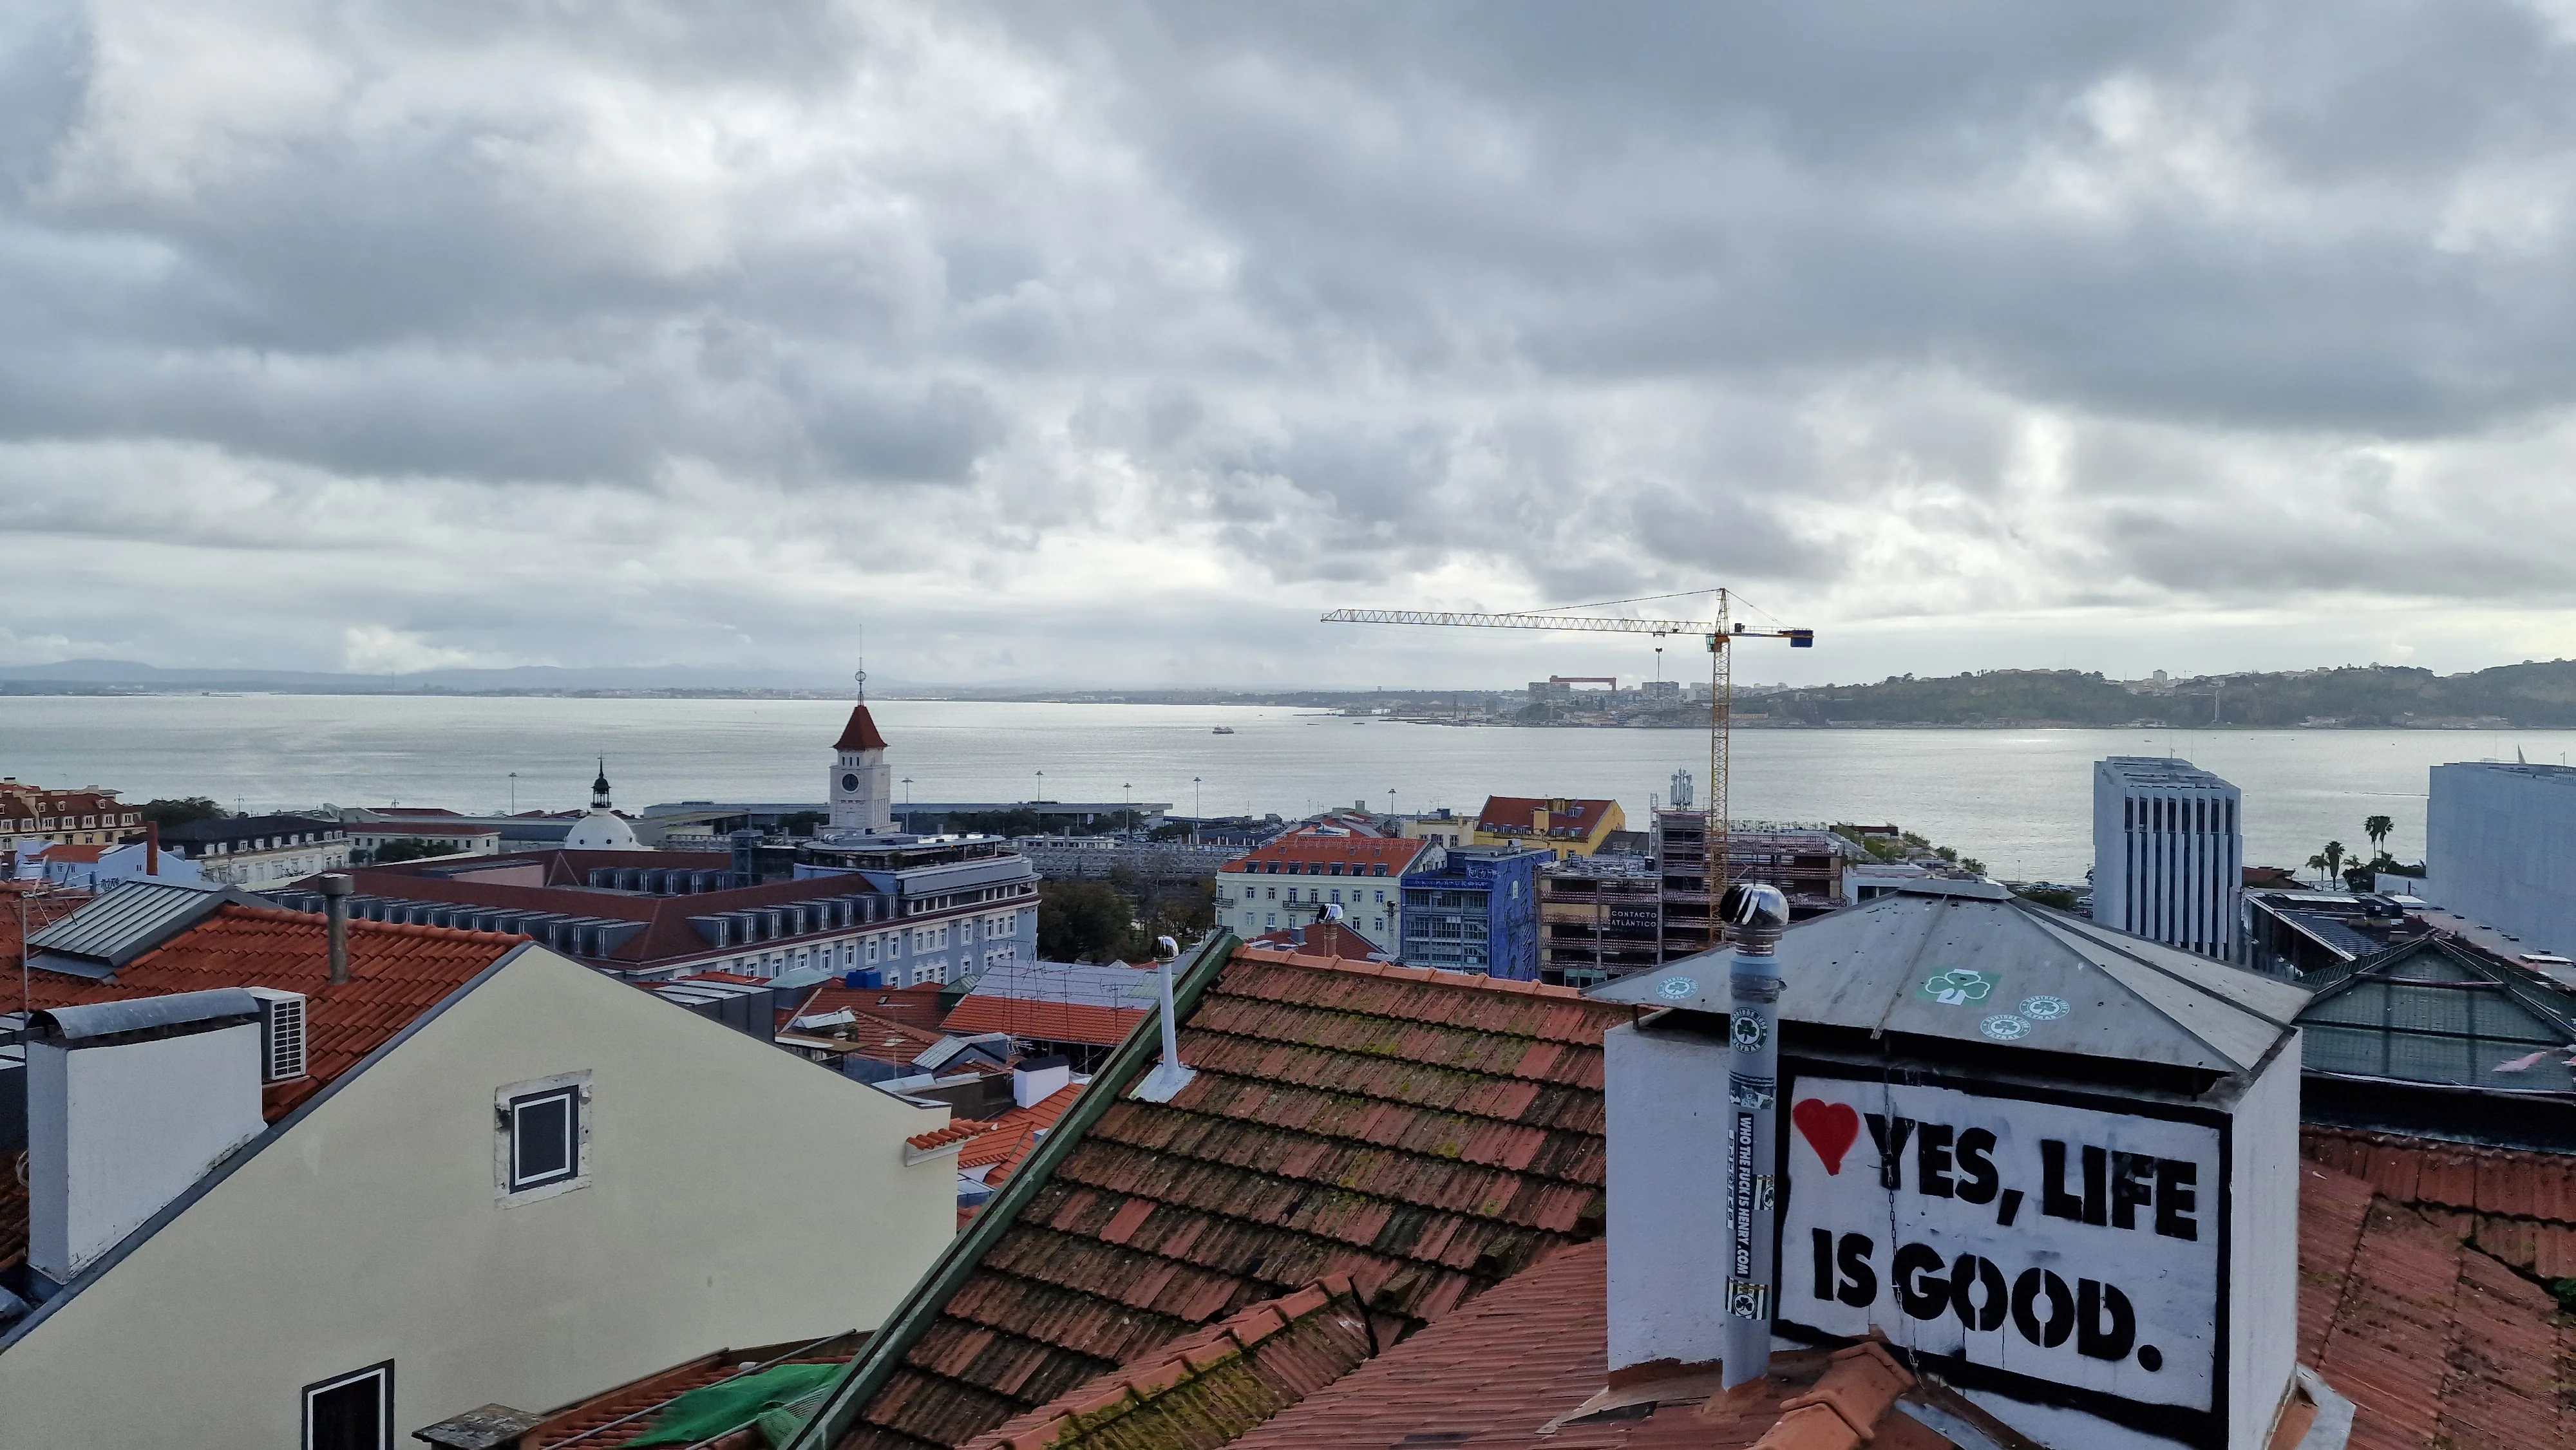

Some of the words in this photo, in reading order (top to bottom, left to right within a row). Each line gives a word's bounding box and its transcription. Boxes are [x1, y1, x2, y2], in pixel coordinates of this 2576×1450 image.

[1739, 1117, 1752, 1145] WHO
[1739, 1146, 1751, 1166] THE
[1739, 1167, 1750, 1196] FUCK
[1863, 1113, 2023, 1226] YES,
[2041, 1139, 2198, 1241] LIFE
[1738, 1196, 1750, 1207] IS
[1812, 1228, 1877, 1308] IS
[1892, 1242, 2163, 1372] GOOD.
